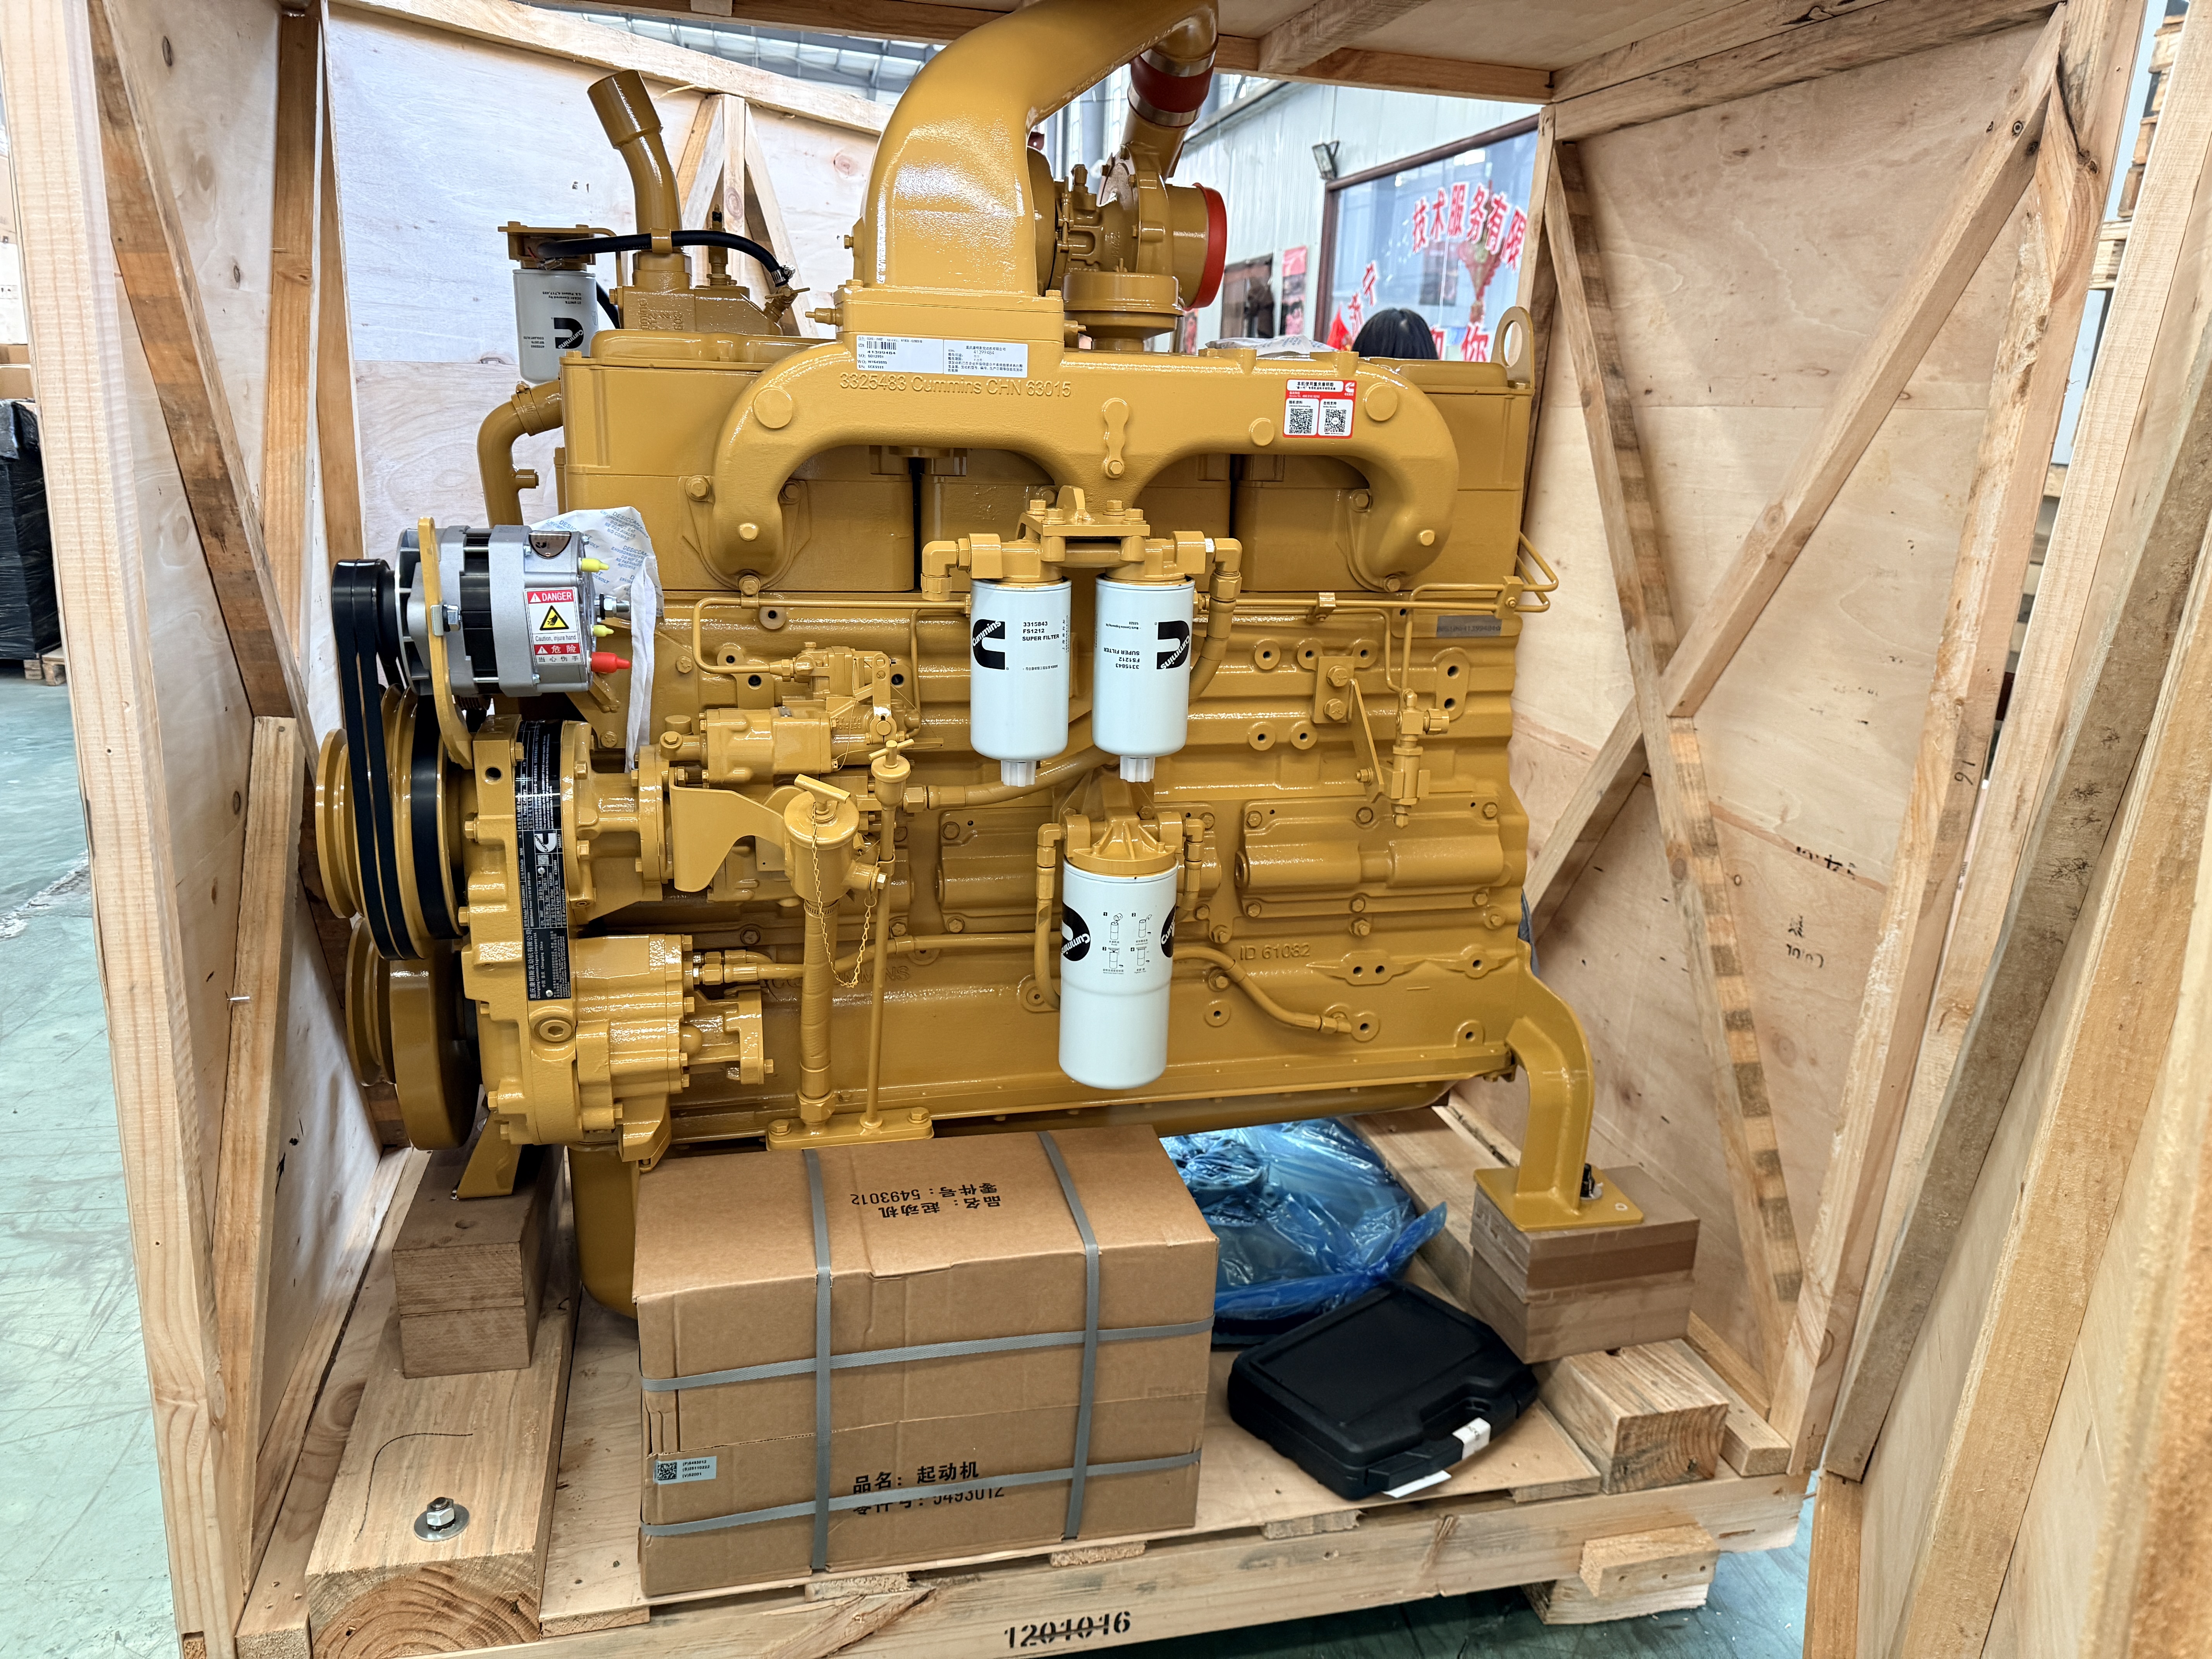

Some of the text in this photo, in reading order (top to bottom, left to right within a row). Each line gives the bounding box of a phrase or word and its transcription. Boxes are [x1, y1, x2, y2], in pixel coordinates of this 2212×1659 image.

[558, 330, 584, 349] Cummins
[840, 372, 1071, 397] 3325483 Cummins CHN 63015
[559, 520, 577, 531] DESIC
[542, 592, 572, 601] DANGER
[972, 620, 1001, 646] Cummins
[551, 645, 577, 654] 危险
[1160, 635, 1190, 670] Cummins
[534, 835, 548, 852] Cummins
[1061, 933, 1090, 955] Cummins
[1240, 945, 1256, 960] ID
[526, 929, 536, 999] 重庆康明斯发动机有限公司
[850, 1188, 921, 1206] 5493012
[878, 1202, 940, 1218] 起动机
[917, 1461, 979, 1484] 起动机
[1004, 1611, 1131, 1649] 1201016
